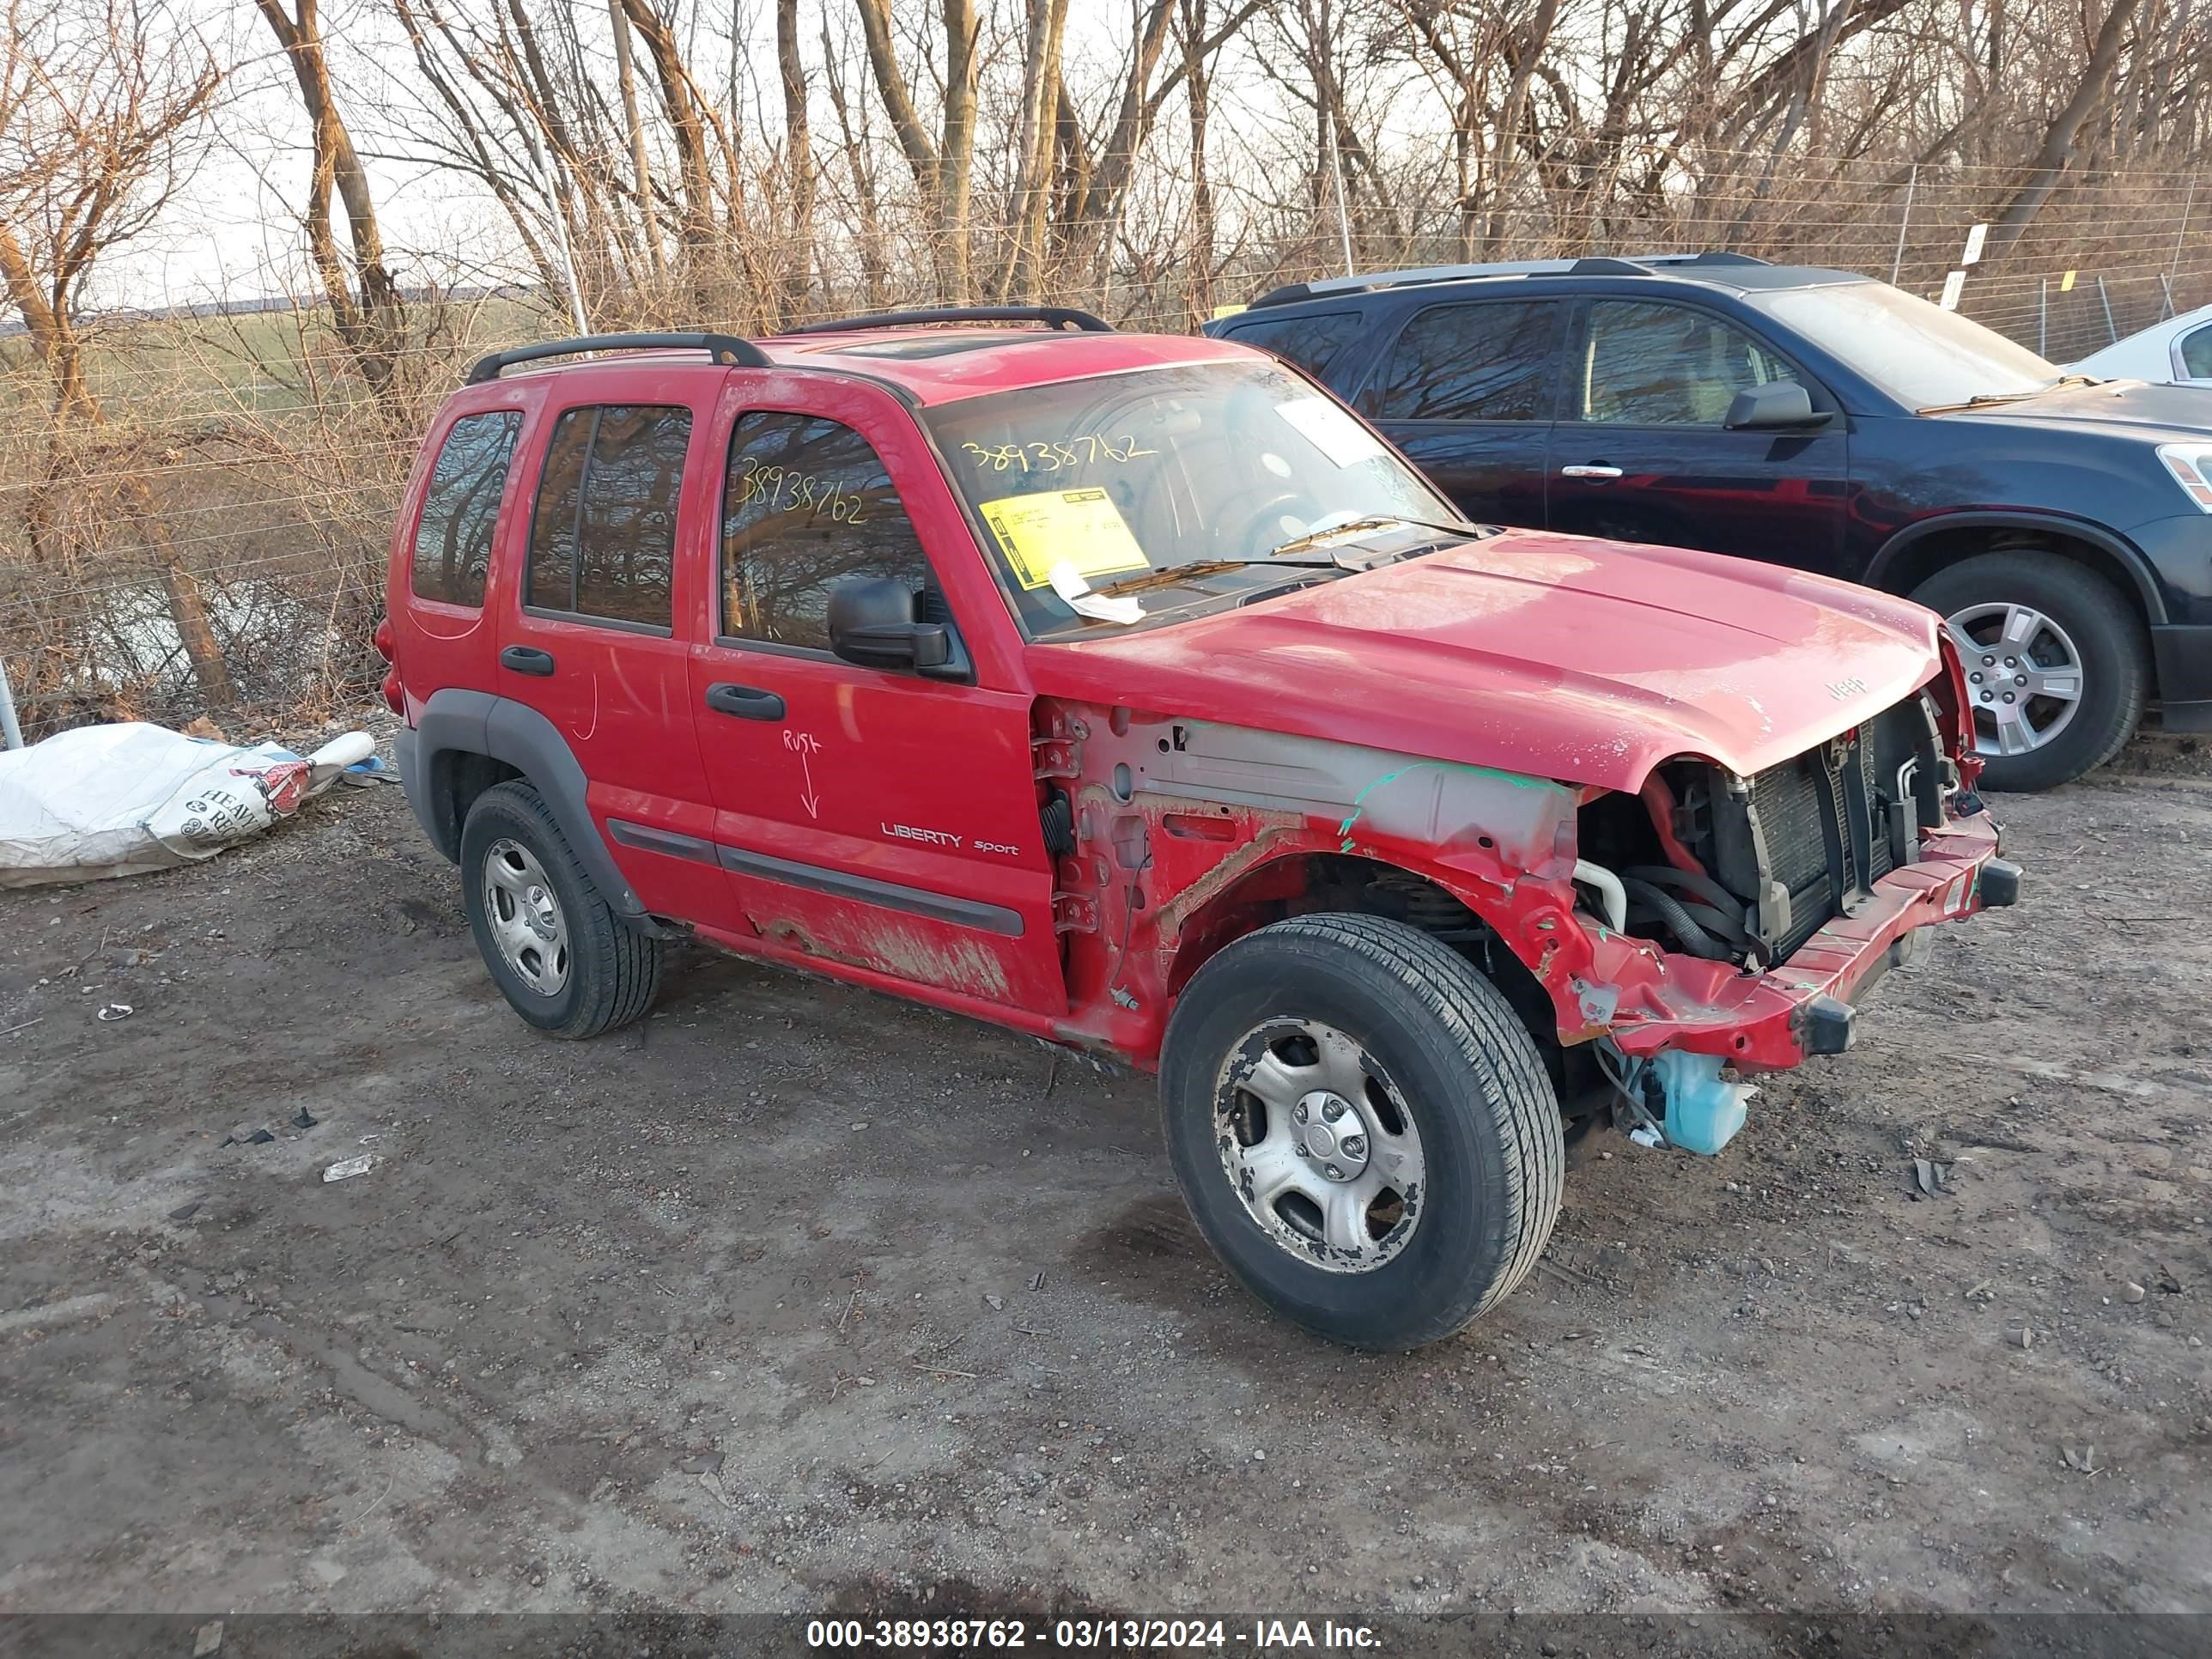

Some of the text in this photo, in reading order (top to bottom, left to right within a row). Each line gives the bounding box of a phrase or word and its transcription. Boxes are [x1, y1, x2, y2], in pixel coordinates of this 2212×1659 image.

[961, 433, 1159, 473] 38938762
[735, 457, 868, 525] 38938762
[201, 789, 258, 828] HEAVY
[881, 821, 1020, 856] LIBERTY sport
